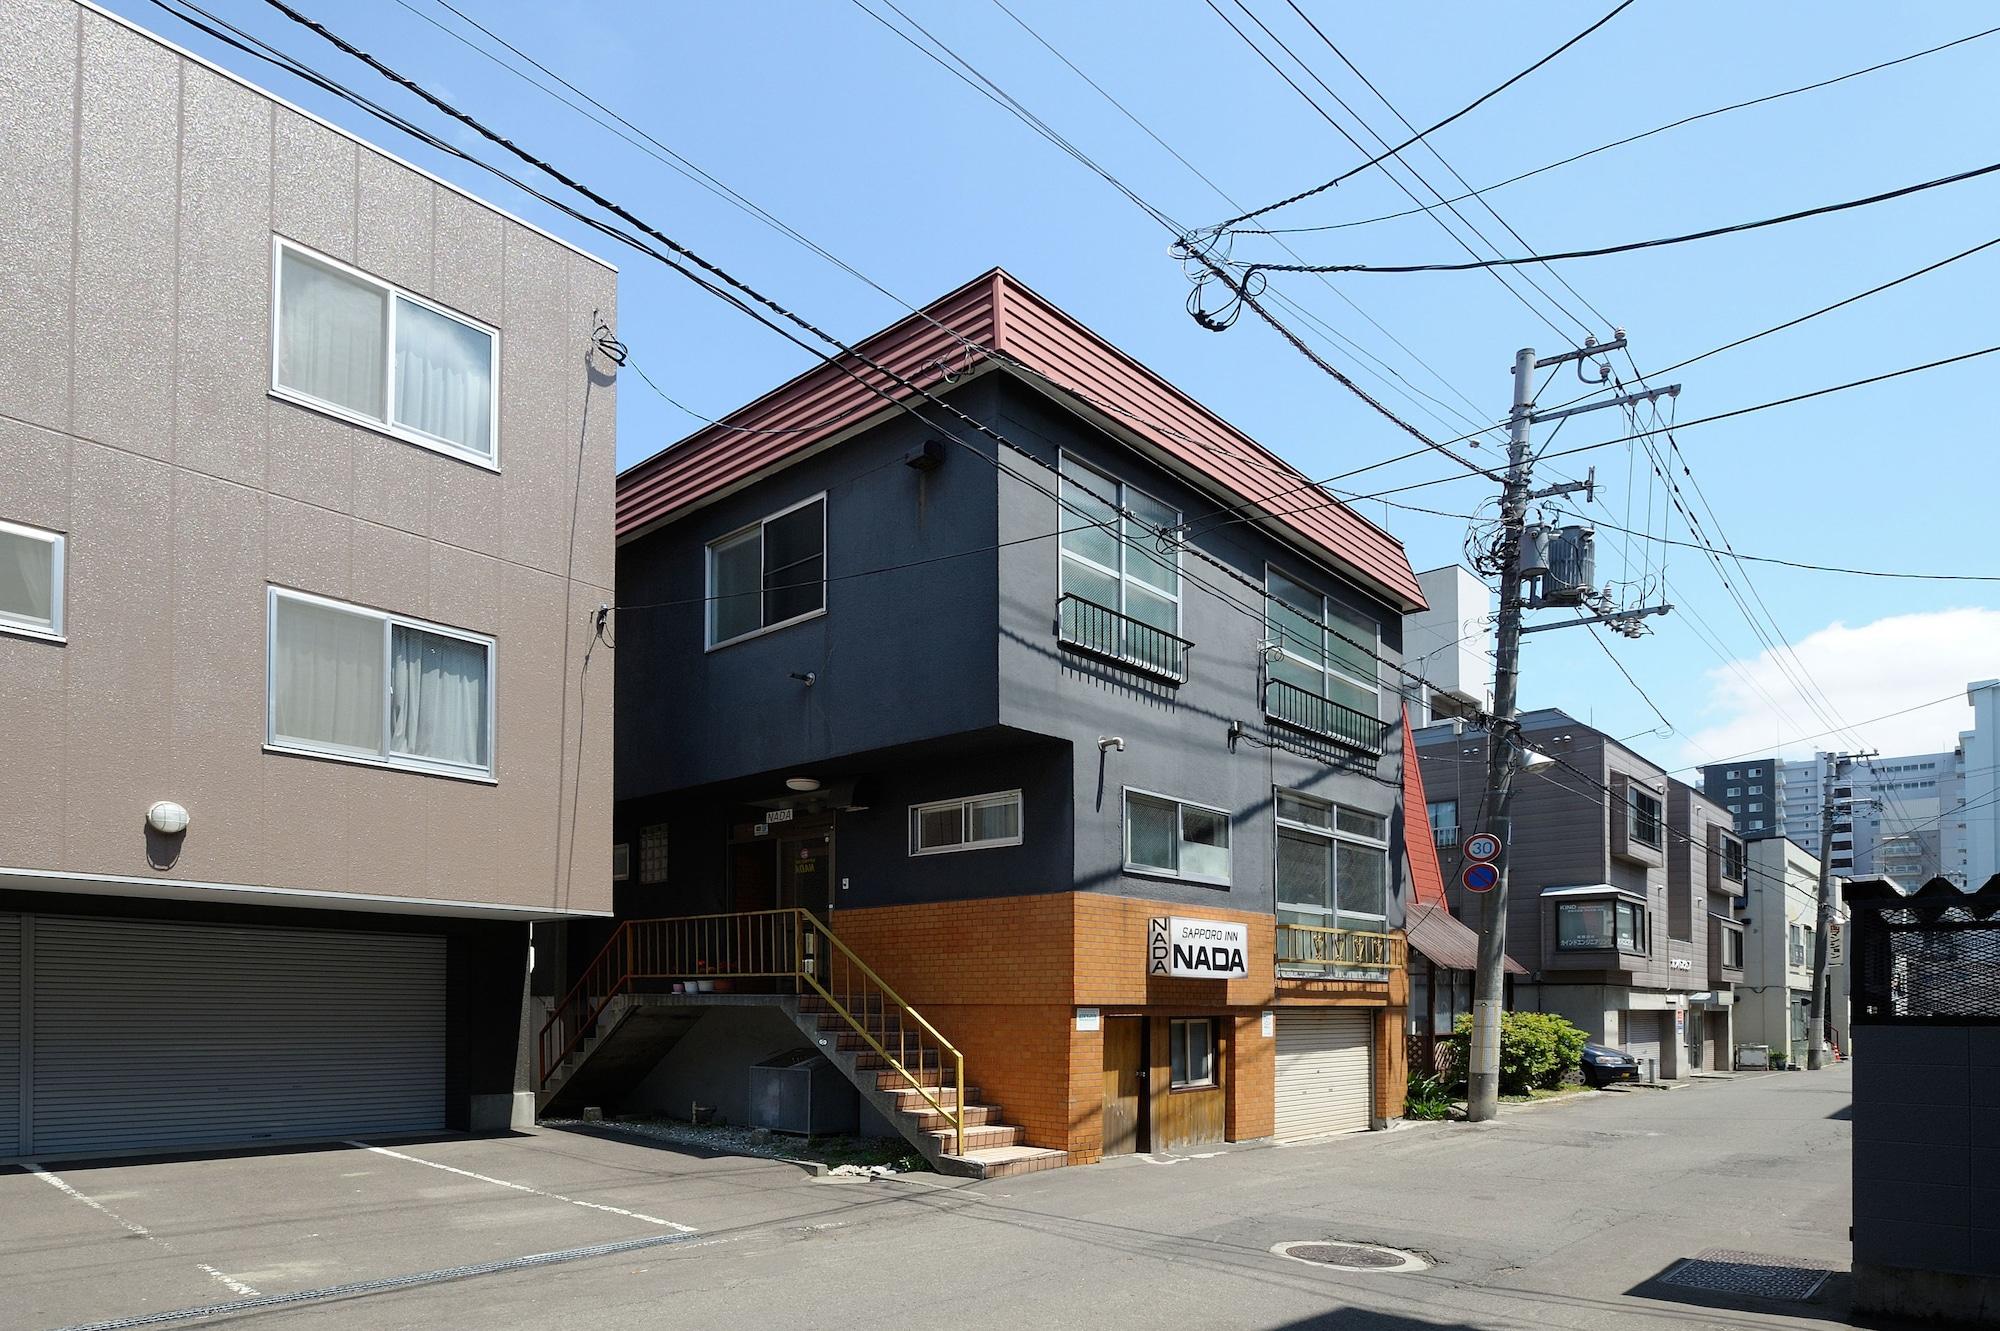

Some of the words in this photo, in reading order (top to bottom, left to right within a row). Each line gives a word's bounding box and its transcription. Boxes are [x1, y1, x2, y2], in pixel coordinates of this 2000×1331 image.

[767, 810, 791, 822] NADA
[1472, 842, 1492, 854] 30
[1182, 927, 1222, 940] SAPPORO
[1225, 931, 1238, 941] INN
[1152, 918, 1168, 974] NADA
[1173, 944, 1245, 972] NADA
